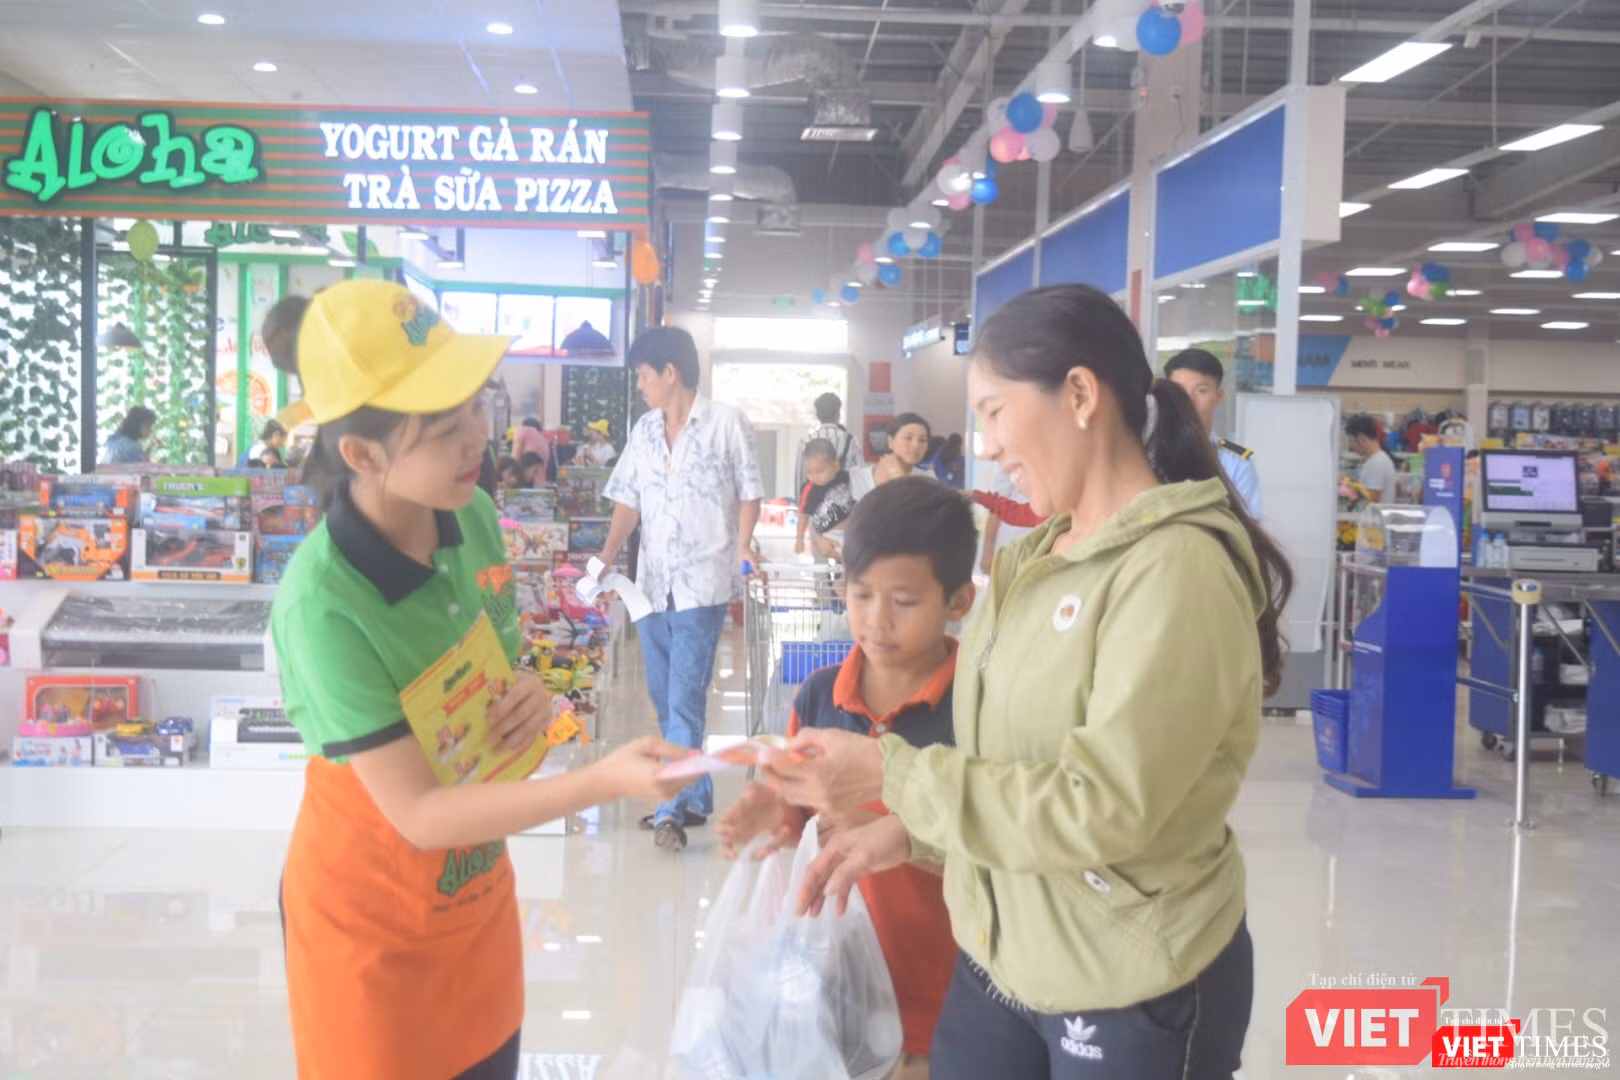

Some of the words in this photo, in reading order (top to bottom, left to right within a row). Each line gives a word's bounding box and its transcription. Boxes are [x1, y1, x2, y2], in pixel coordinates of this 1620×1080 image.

[6, 109, 259, 201] Aloha
[320, 122, 460, 160] YOGURT
[469, 117, 519, 162] GÀ
[530, 118, 609, 164] RÁN
[343, 164, 420, 209] TRÀ
[434, 167, 502, 211] SỮA
[514, 176, 618, 214] PIZZA
[1061, 1036, 1103, 1060] adidas
